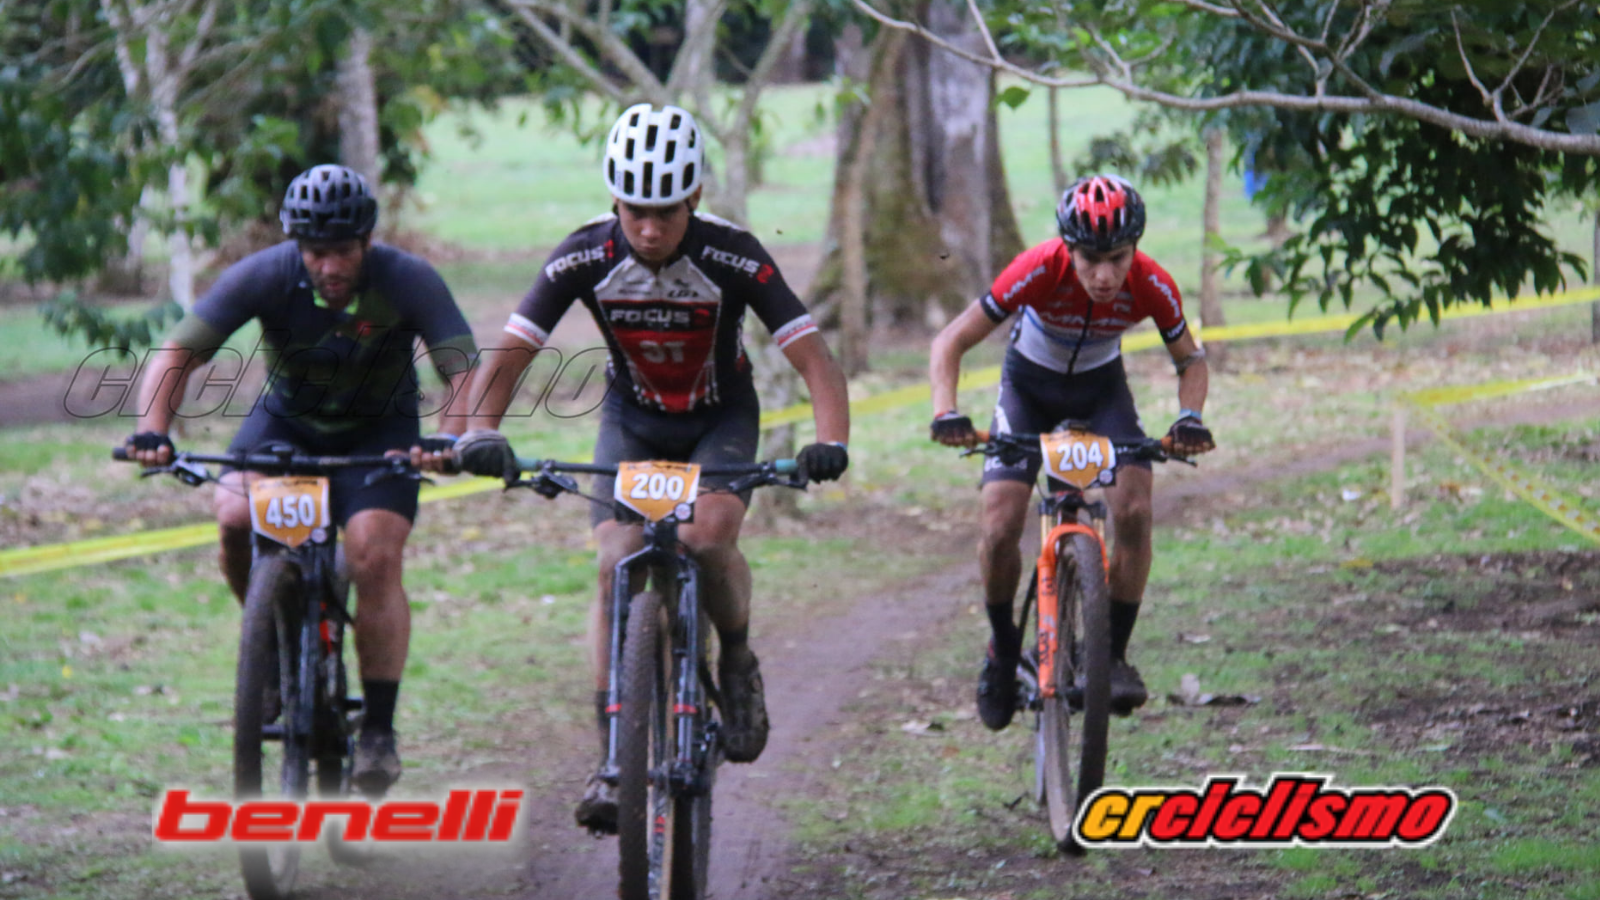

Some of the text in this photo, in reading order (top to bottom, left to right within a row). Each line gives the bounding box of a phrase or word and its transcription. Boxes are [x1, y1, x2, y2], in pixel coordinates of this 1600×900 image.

[545, 245, 605, 279] FOCUS
[702, 245, 760, 276] FOCUS
[610, 308, 690, 323] FOCUS
[1057, 442, 1103, 471] 204
[630, 473, 685, 500] 200
[266, 494, 315, 528] 450
